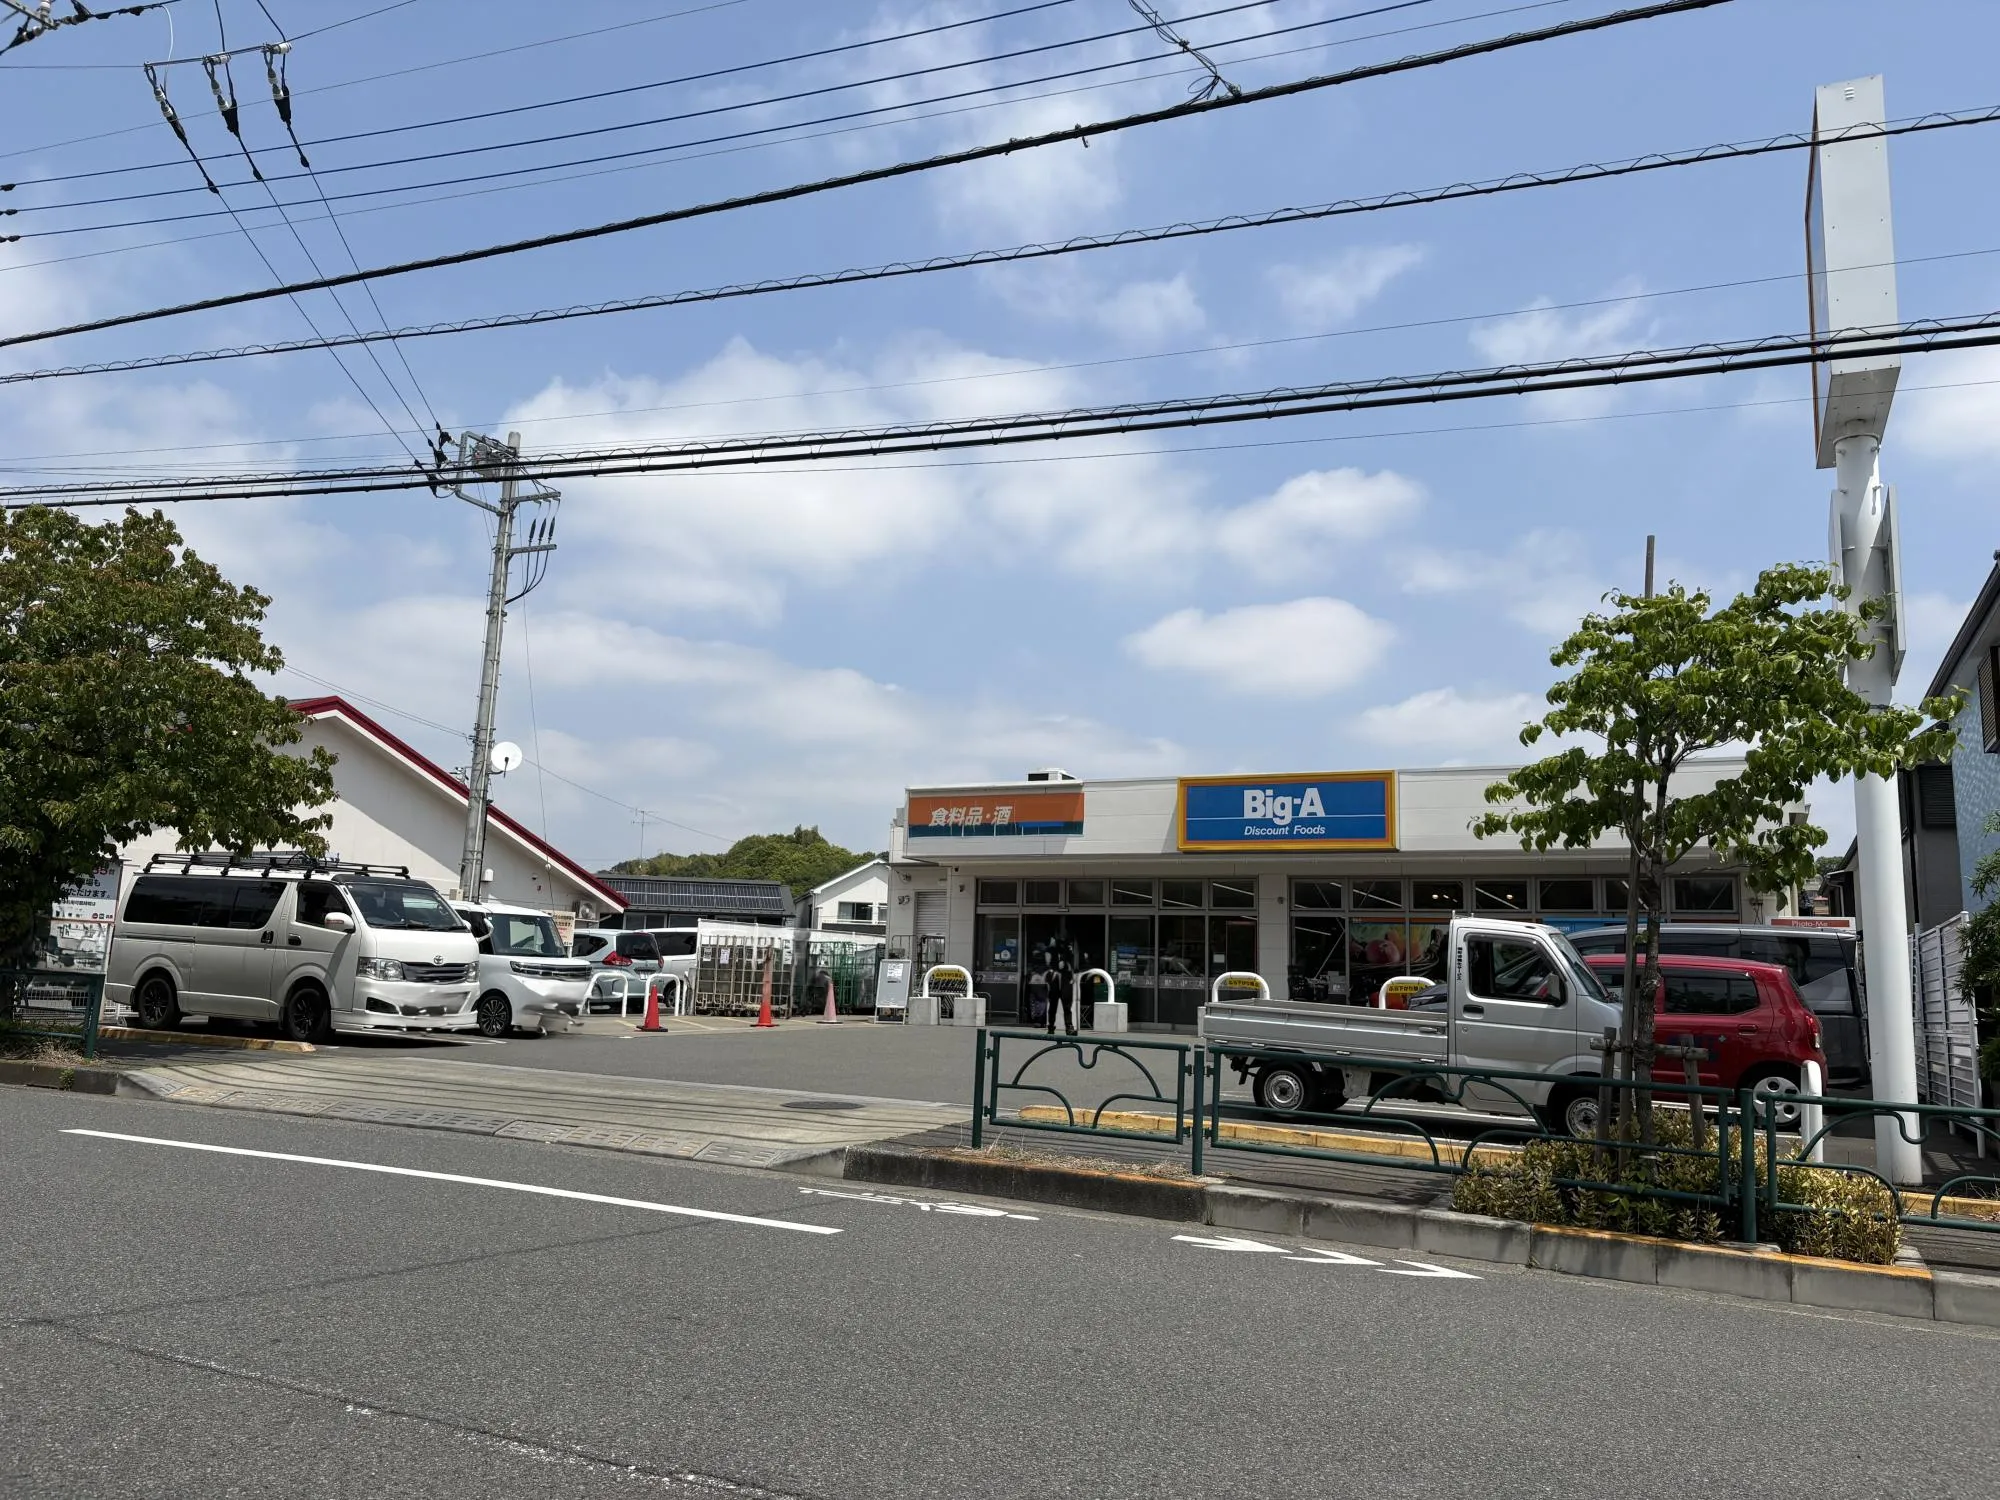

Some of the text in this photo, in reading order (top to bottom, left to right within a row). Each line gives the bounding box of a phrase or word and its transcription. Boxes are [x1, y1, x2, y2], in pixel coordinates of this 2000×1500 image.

[1243, 787, 1326, 825] Big-A
[1244, 824, 1326, 836] Discount Foods
